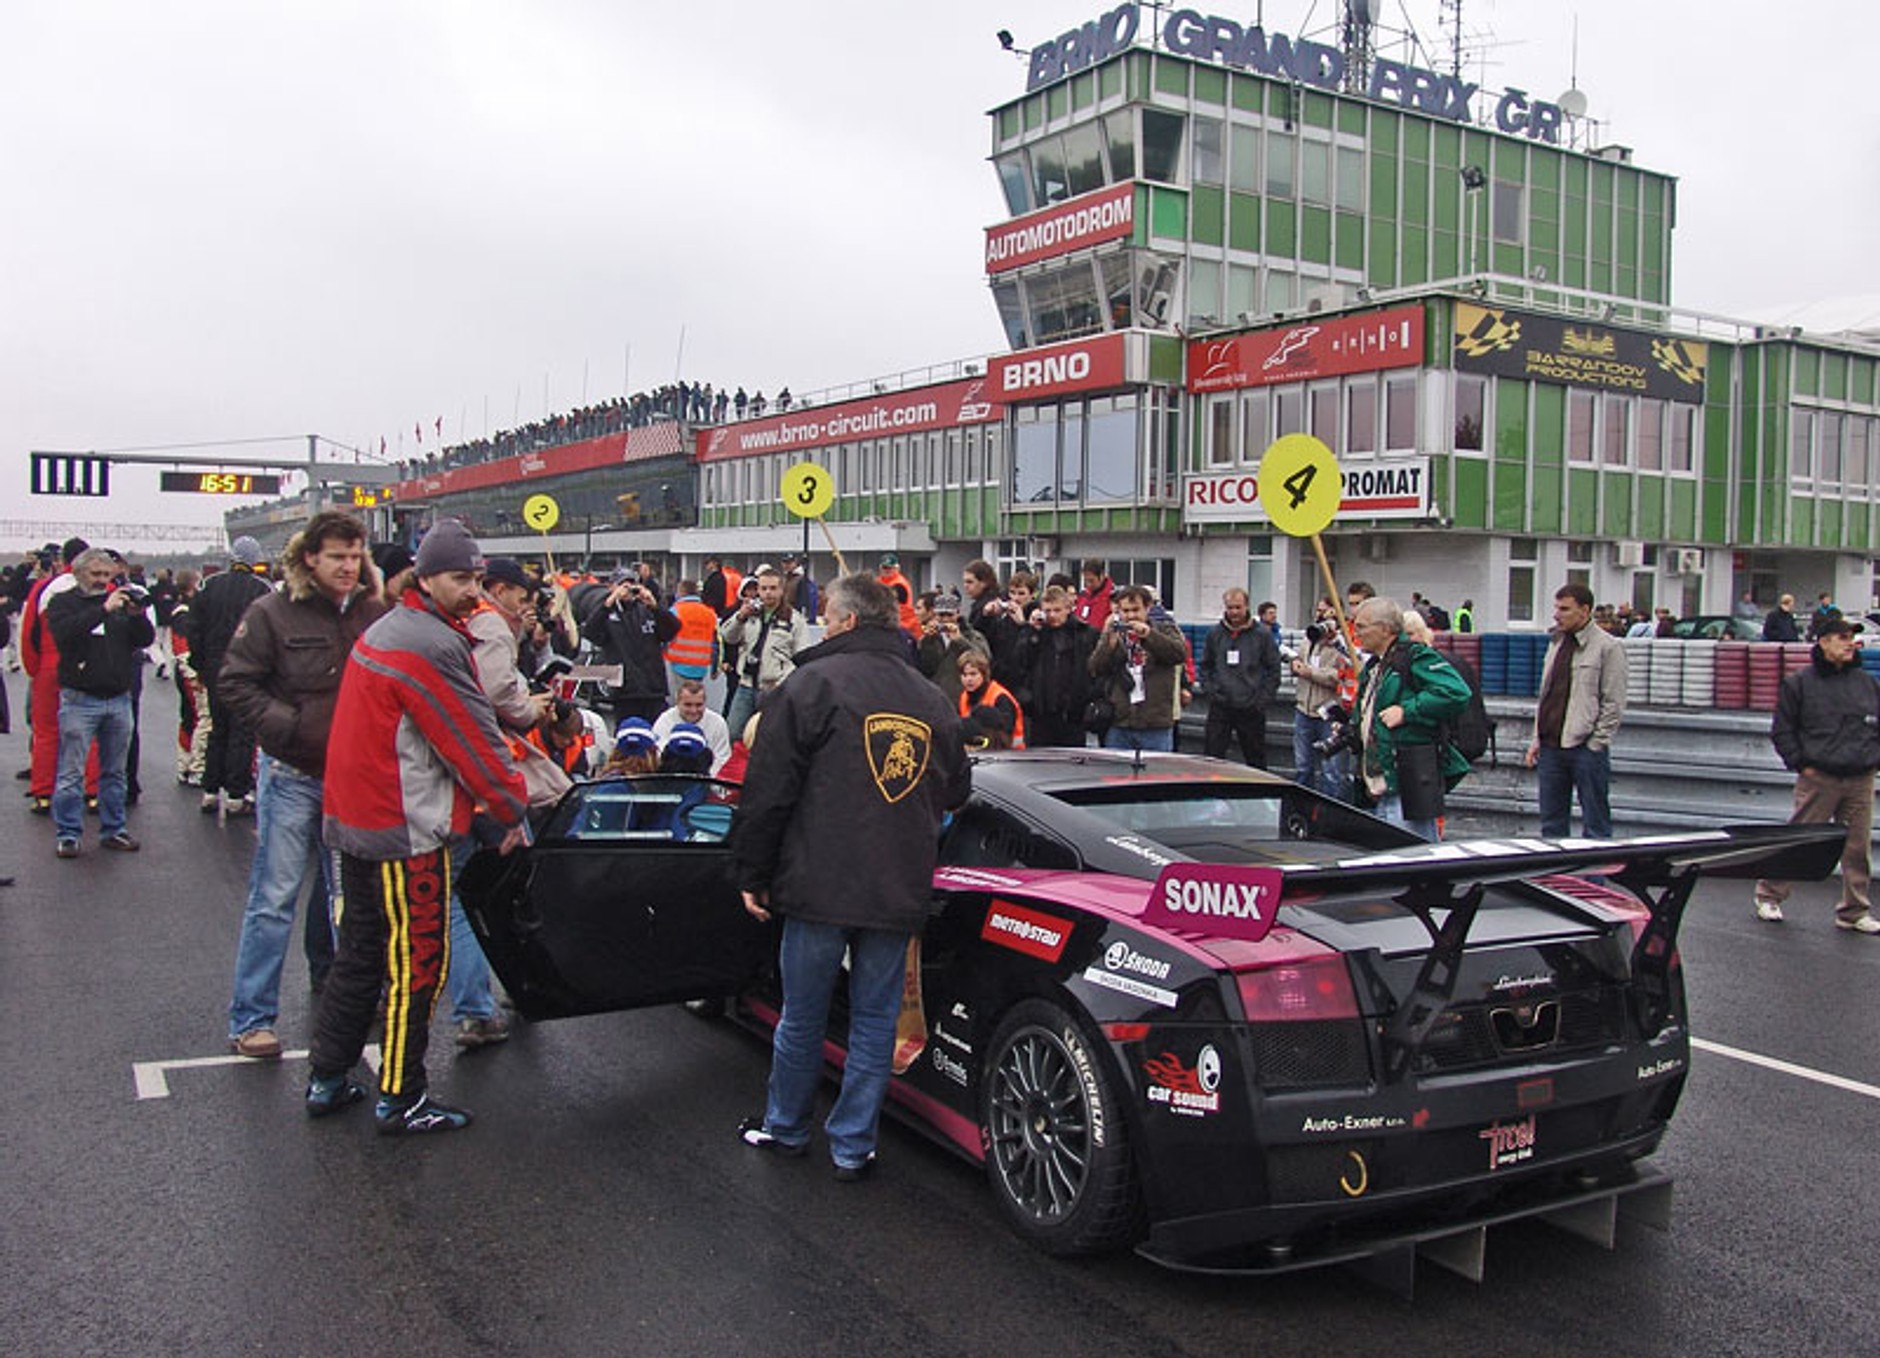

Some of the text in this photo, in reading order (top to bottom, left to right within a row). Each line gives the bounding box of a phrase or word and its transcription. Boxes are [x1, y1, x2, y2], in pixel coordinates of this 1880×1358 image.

[1026, 2, 1562, 144] BRNO GRAND PRIX ČR
[986, 194, 1132, 264] AUTOMOTODROM
[1003, 351, 1090, 391] BRNO
[799, 476, 817, 504] 3
[1283, 464, 1318, 510] 4
[533, 504, 549, 523] 2
[1165, 878, 1261, 920] SONAX
[1074, 1047, 1105, 1148] MICHELIN
[1147, 1085, 1219, 1111] car sound
[1302, 1115, 1384, 1132] Auto-Exner
